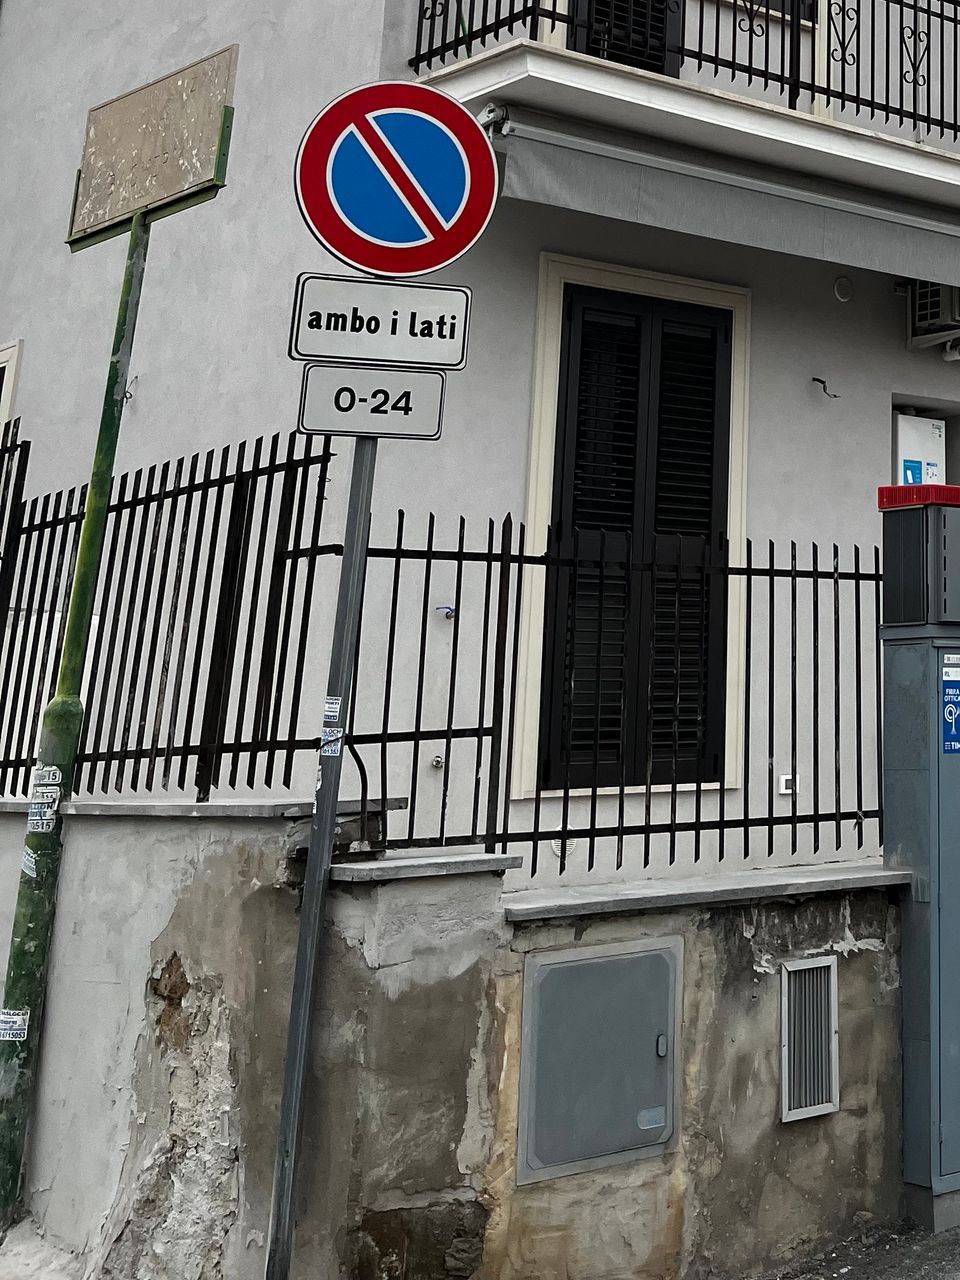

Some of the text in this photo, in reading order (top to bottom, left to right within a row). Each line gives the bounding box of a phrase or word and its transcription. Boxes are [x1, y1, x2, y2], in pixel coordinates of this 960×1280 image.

[307, 307, 457, 340] ambo i lati
[333, 386, 413, 416] 0-24
